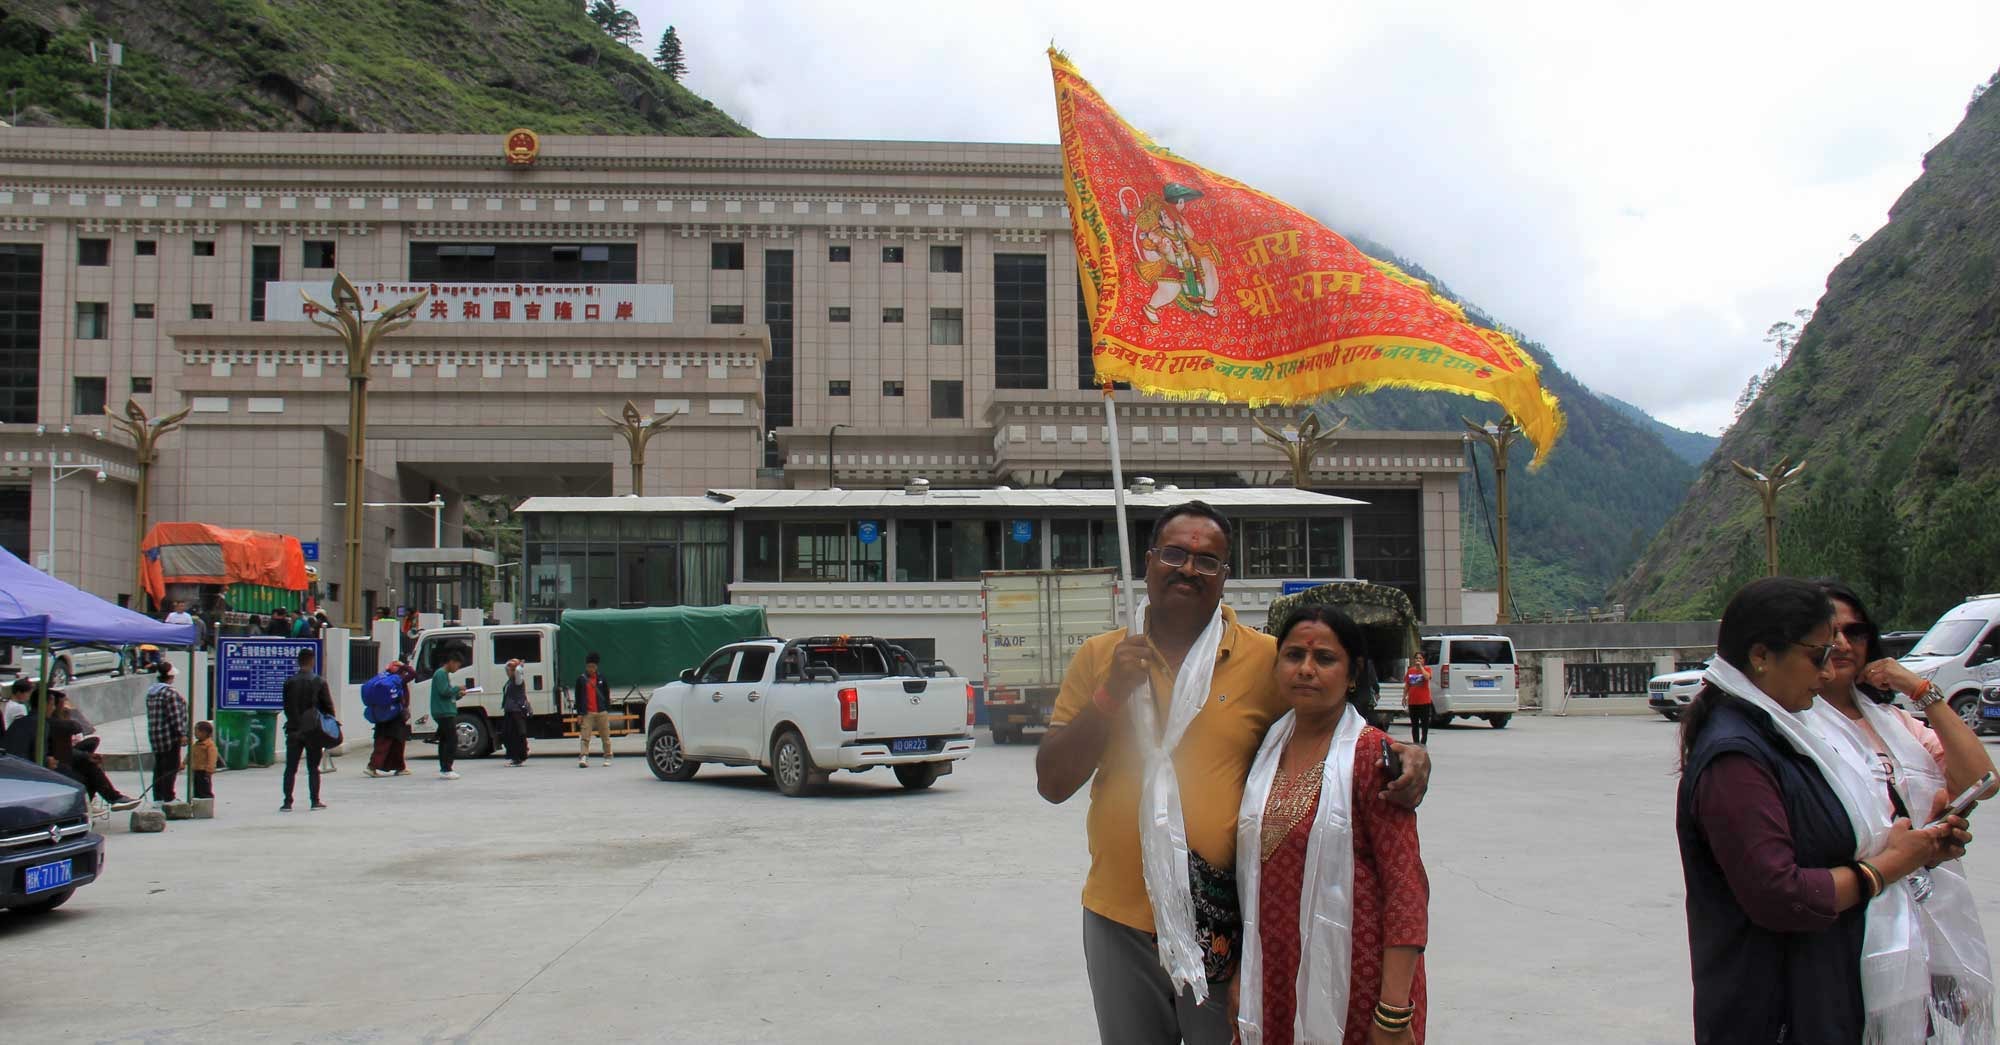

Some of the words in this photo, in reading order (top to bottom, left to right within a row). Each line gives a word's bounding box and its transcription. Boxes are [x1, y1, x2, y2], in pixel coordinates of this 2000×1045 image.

[1236, 229, 1303, 266] जय
[302, 299, 634, 321] 中共和国吉隆口岸
[1236, 274, 1282, 317] श्री
[1289, 271, 1367, 302] राम
[1108, 342, 1142, 366] जय
[1140, 352, 1168, 373] श्री
[1168, 355, 1205, 375] राम
[1067, 635, 1092, 645] 05
